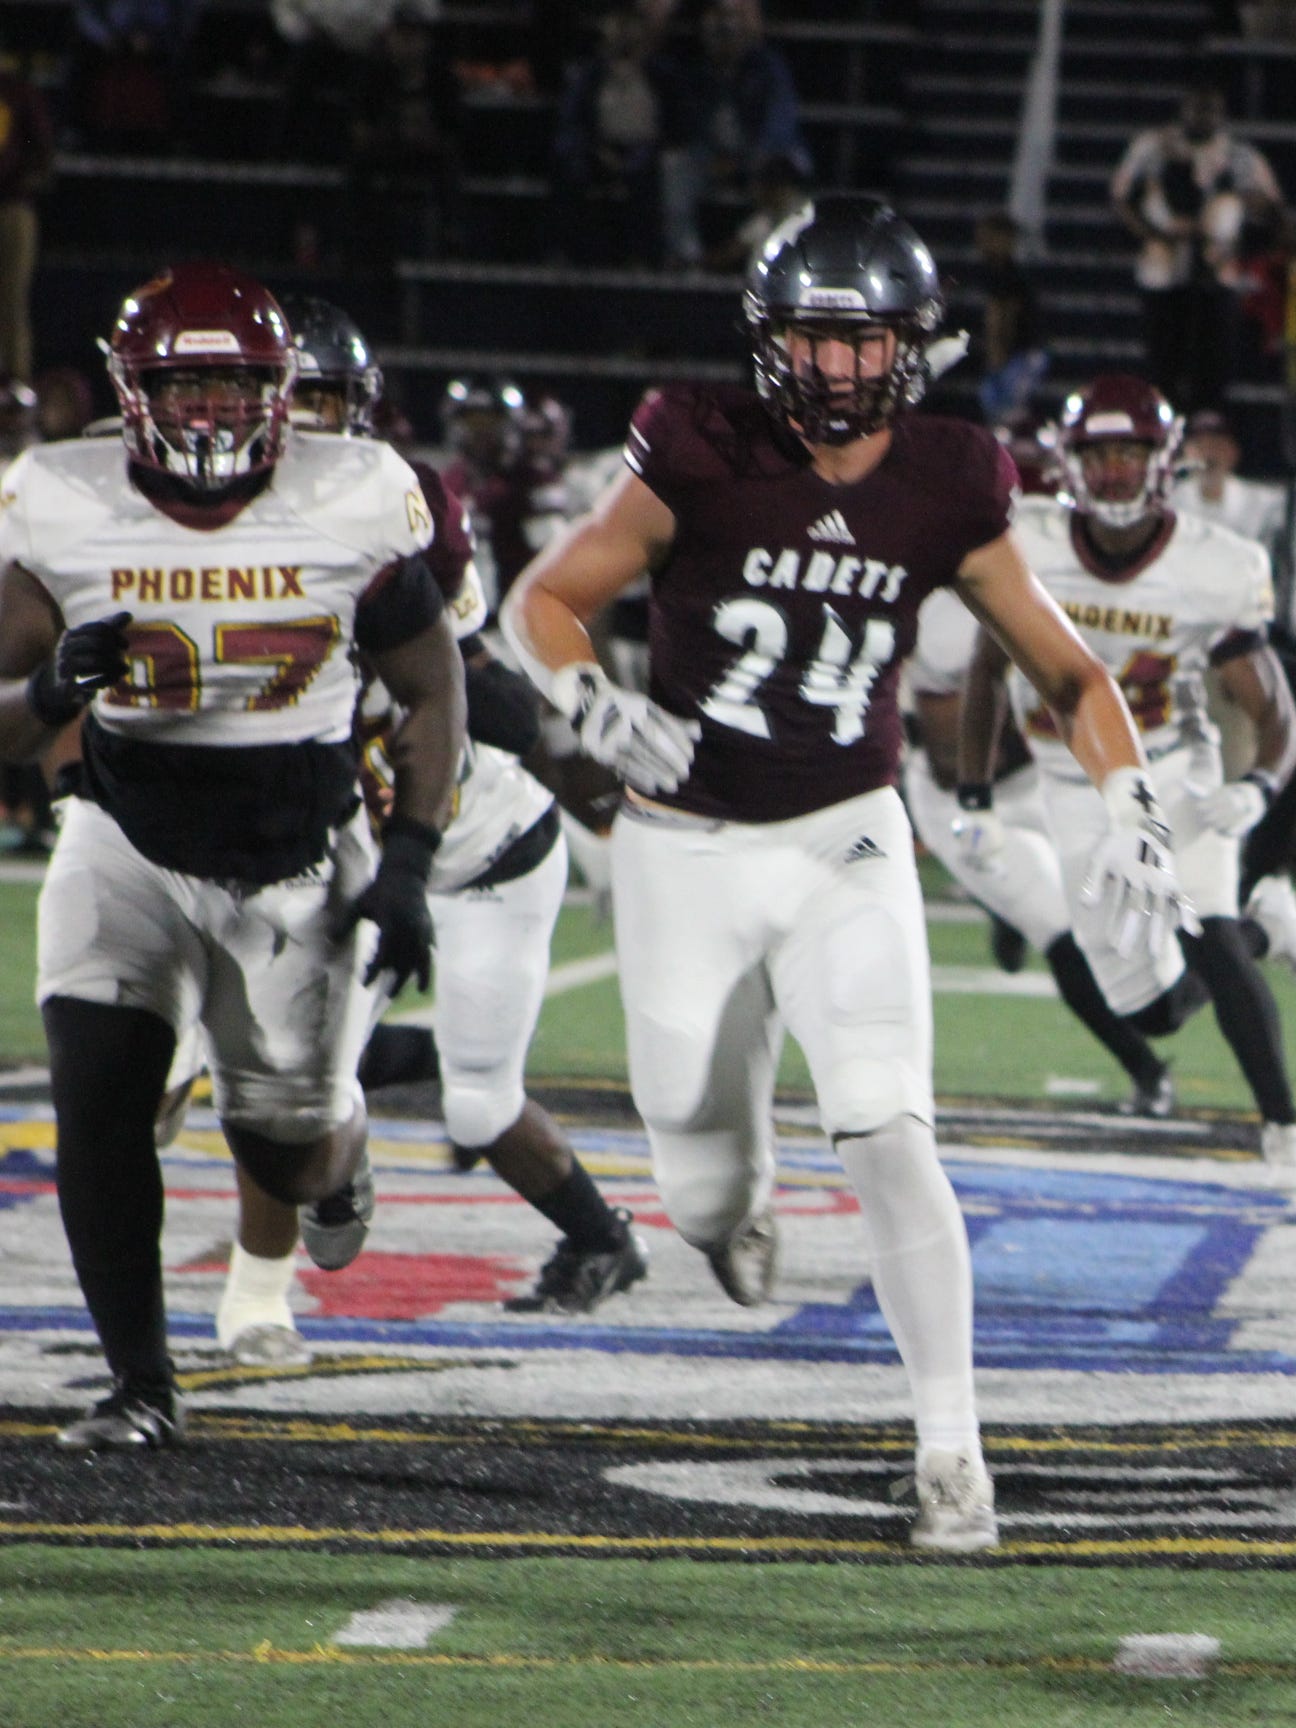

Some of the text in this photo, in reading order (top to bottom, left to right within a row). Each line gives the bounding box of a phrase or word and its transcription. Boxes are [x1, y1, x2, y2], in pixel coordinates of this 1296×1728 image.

[110, 565, 305, 602] PHOENIX
[742, 547, 909, 603] CADETS
[1061, 602, 1174, 641] HOENIX
[698, 598, 896, 746] 24
